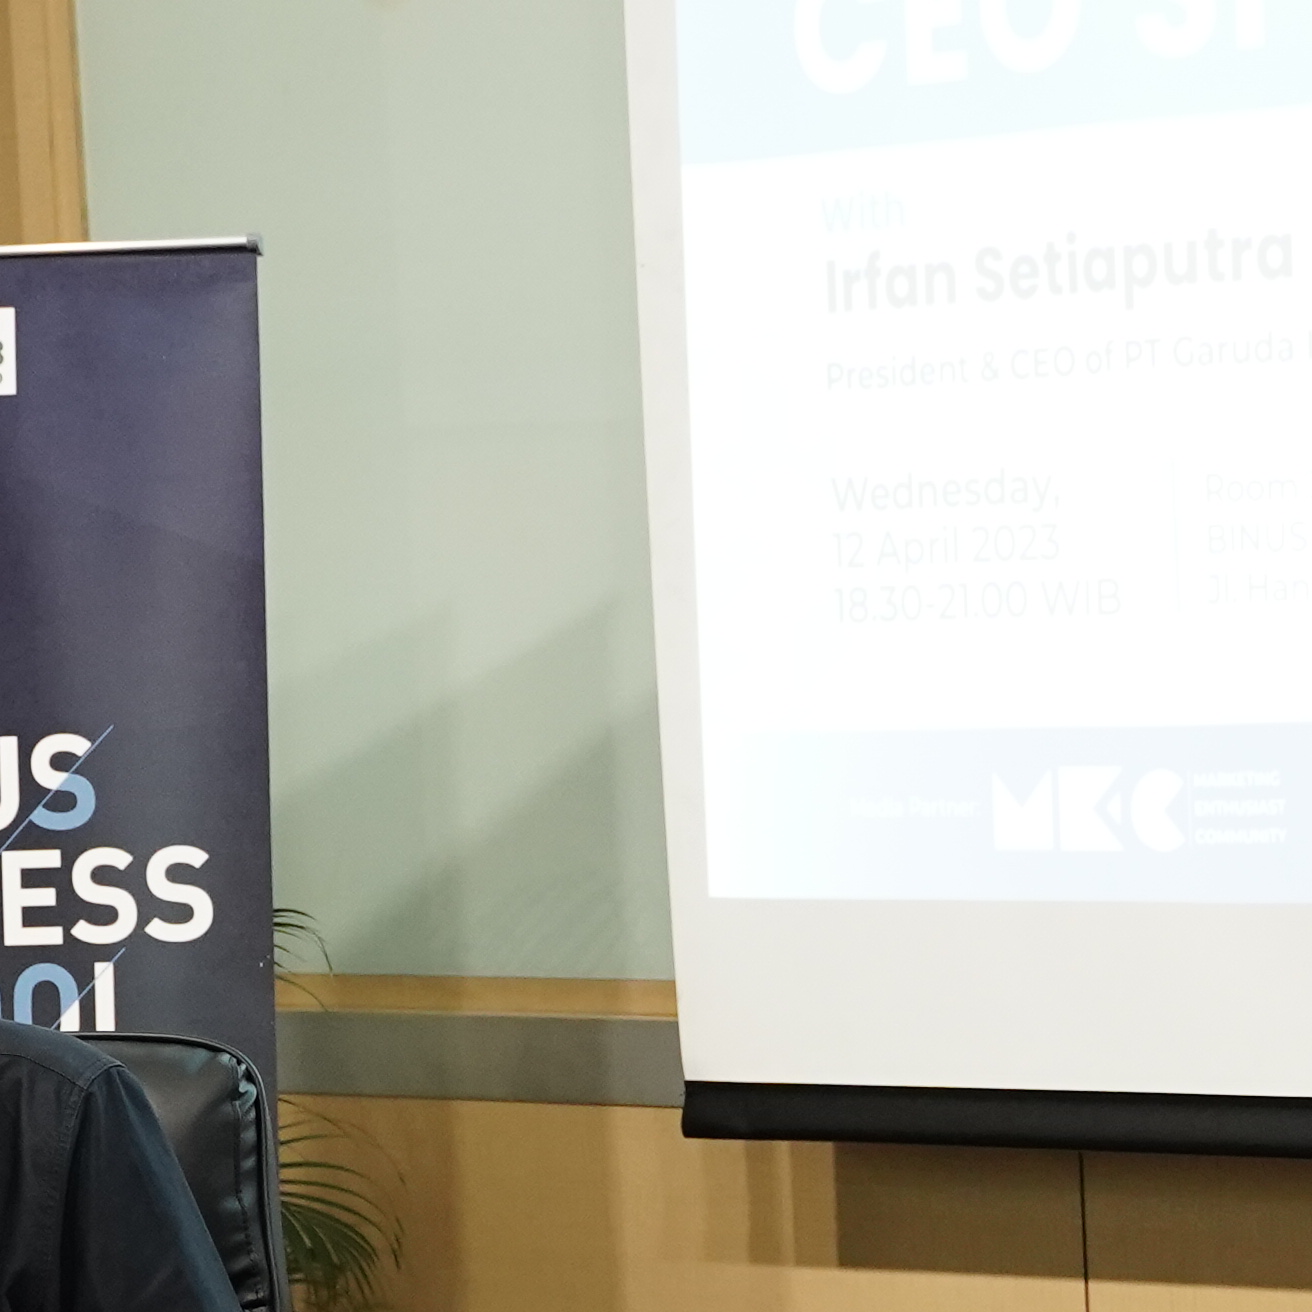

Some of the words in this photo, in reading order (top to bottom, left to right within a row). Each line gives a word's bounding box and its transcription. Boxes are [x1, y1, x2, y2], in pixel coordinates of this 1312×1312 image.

[825, 249, 958, 315] Irfan
[974, 227, 1295, 311] Setiaputra
[826, 355, 969, 391] President
[1009, 345, 1077, 380] CEO
[1085, 339, 1115, 375] of
[1124, 337, 1161, 369] PT
[1172, 330, 1295, 368] Garuda
[832, 531, 865, 569] 12
[876, 525, 960, 573] April
[971, 523, 1061, 564] 2023
[1041, 577, 1122, 616] WIB
